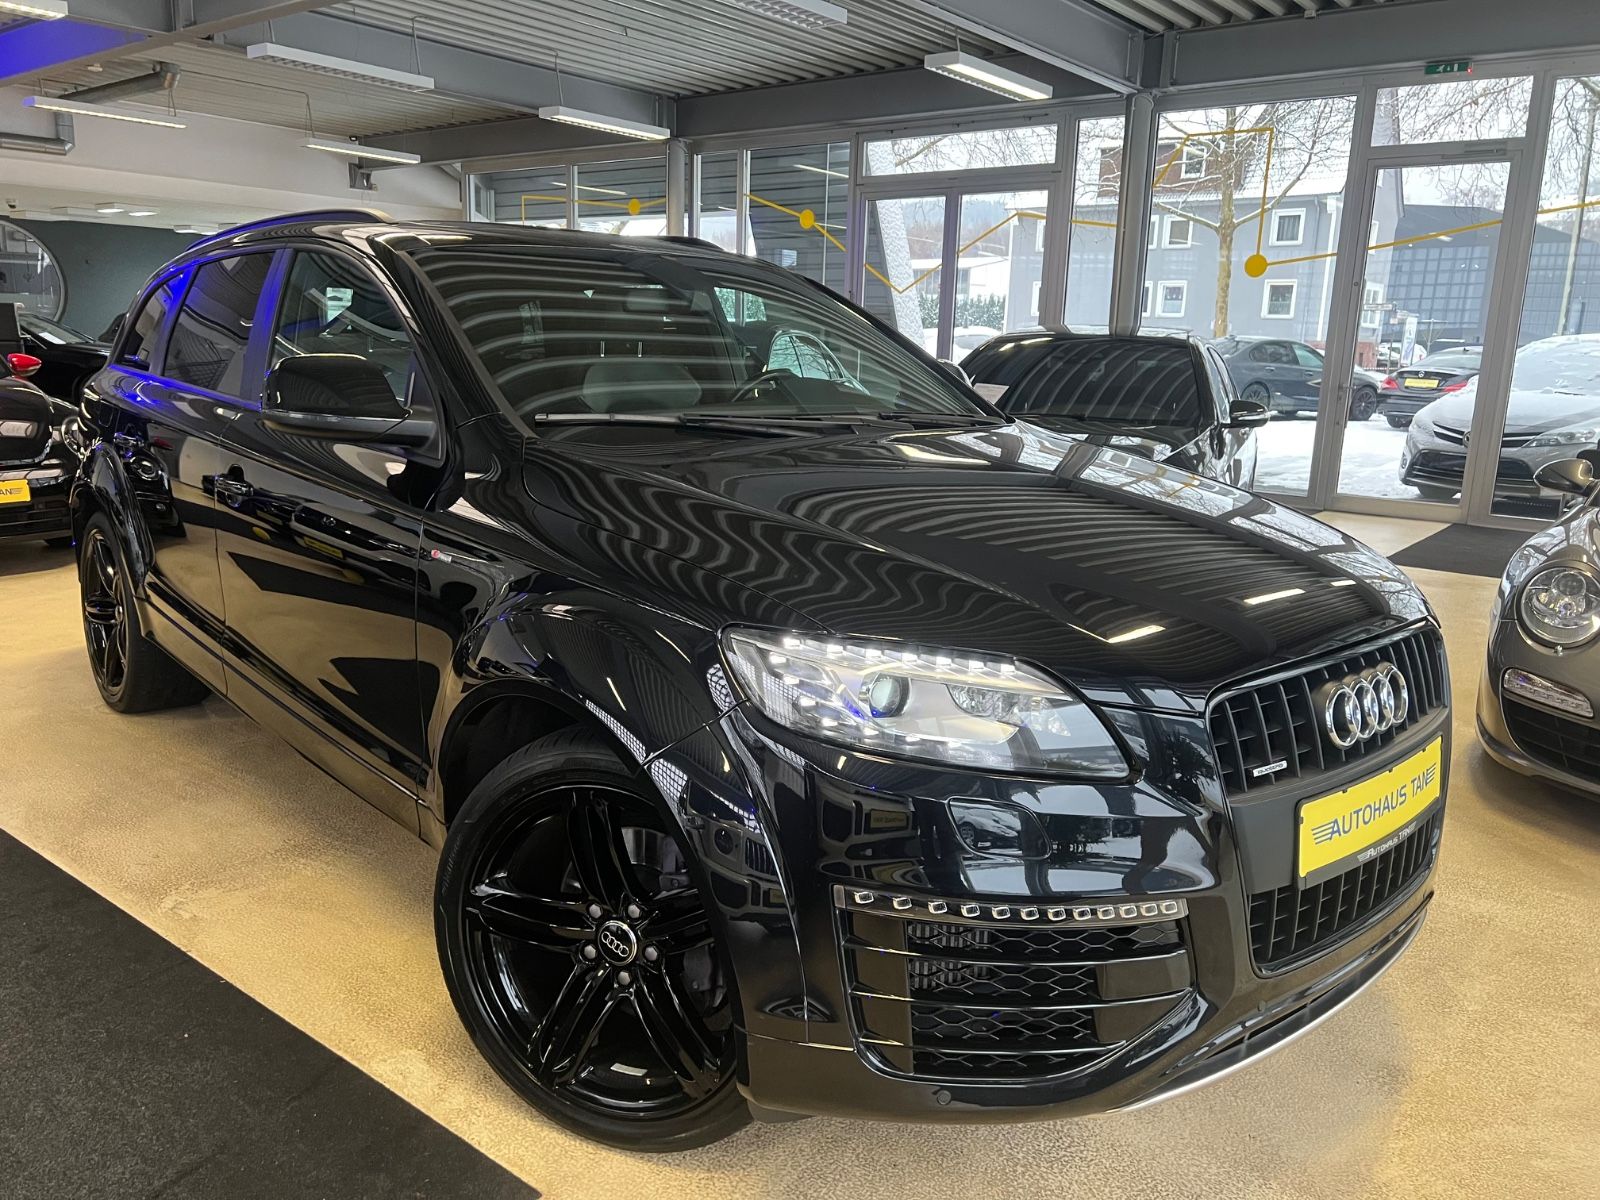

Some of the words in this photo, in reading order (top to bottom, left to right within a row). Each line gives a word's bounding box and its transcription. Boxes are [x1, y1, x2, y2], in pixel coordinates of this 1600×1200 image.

[0, 488, 12, 496] AN
[1330, 784, 1407, 840] AUTOHAUS
[1411, 769, 1429, 798] TAN
